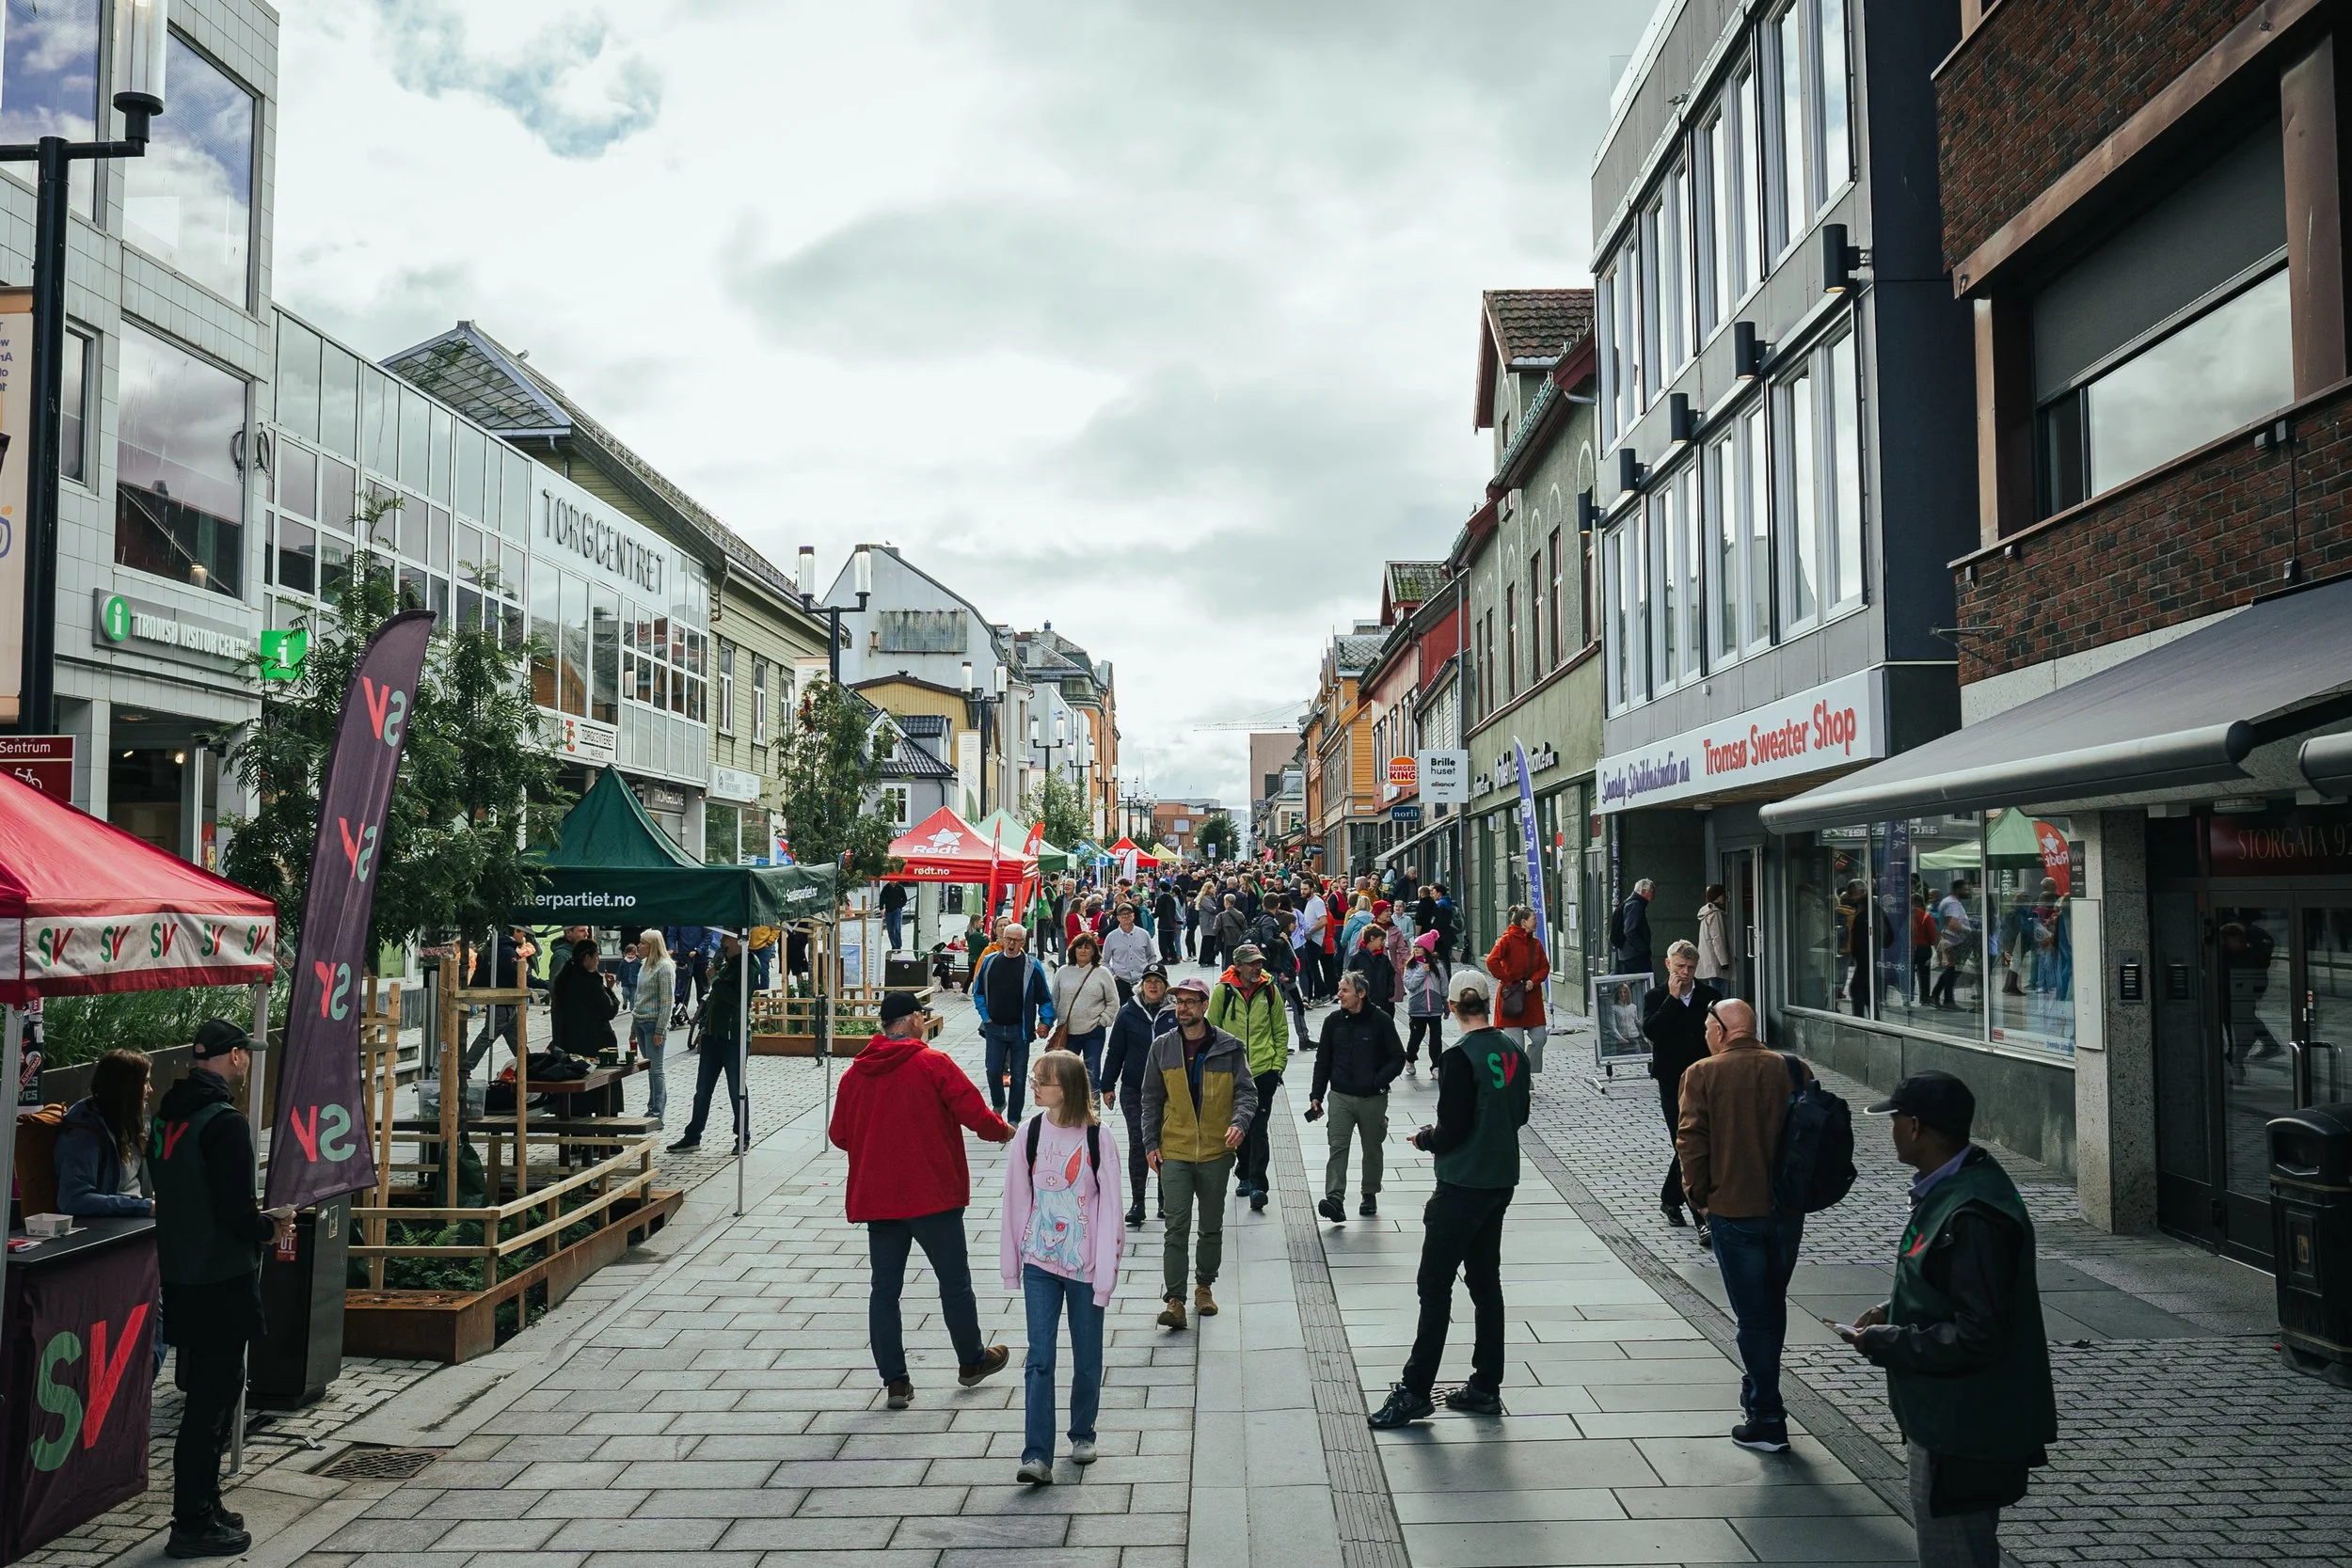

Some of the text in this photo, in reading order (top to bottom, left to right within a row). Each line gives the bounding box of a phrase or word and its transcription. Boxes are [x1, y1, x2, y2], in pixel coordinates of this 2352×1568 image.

[543, 487, 665, 595] TORGCENTRET
[135, 611, 178, 644] TROMSØ
[181, 624, 217, 652] VISITOR
[0, 741, 51, 753] Sentrum
[1703, 699, 1856, 775] Tromsø Sweater Shop
[1431, 758, 1455, 767] Brille
[1431, 767, 1455, 775] huset
[1394, 809, 1418, 817] norli
[912, 845, 961, 855] Rødt
[2237, 826, 2328, 860] STORGATA
[914, 865, 950, 876] rødt.no
[38, 922, 270, 967] SV SV SV SV SV
[1487, 1051, 1518, 1088] SV
[153, 1117, 188, 1160] SV
[30, 1303, 149, 1472] SV
